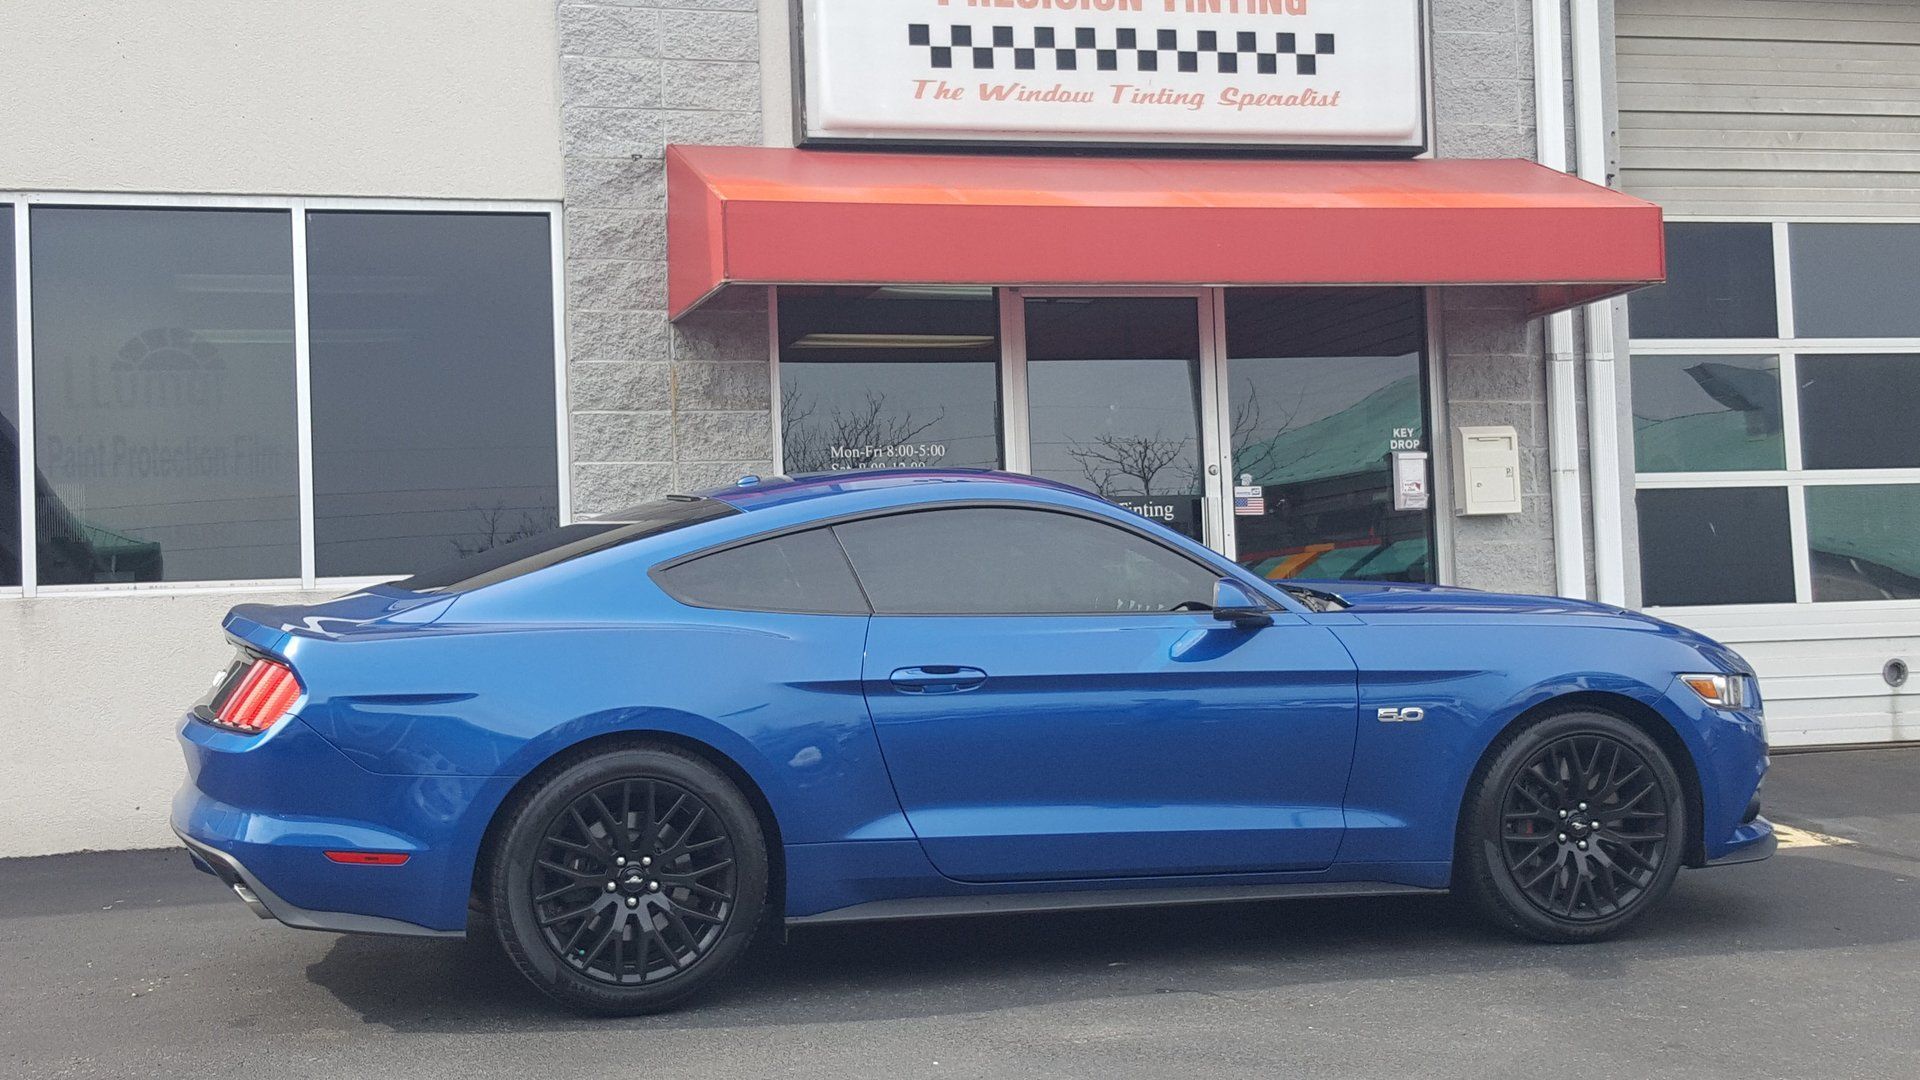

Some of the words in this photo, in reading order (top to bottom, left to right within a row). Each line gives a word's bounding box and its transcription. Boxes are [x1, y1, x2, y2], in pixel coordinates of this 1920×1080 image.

[912, 79, 964, 101] The
[979, 82, 1094, 103] Window
[1110, 84, 1206, 110] Tinting
[1217, 87, 1340, 111] Specialist
[1393, 428, 1414, 438] KEY
[830, 445, 882, 458] Mon-Fri
[886, 444, 945, 457] 8:00-5:00
[1390, 440, 1420, 450] DROP
[1119, 501, 1175, 521] nting
[1377, 707, 1424, 722] 5.0
